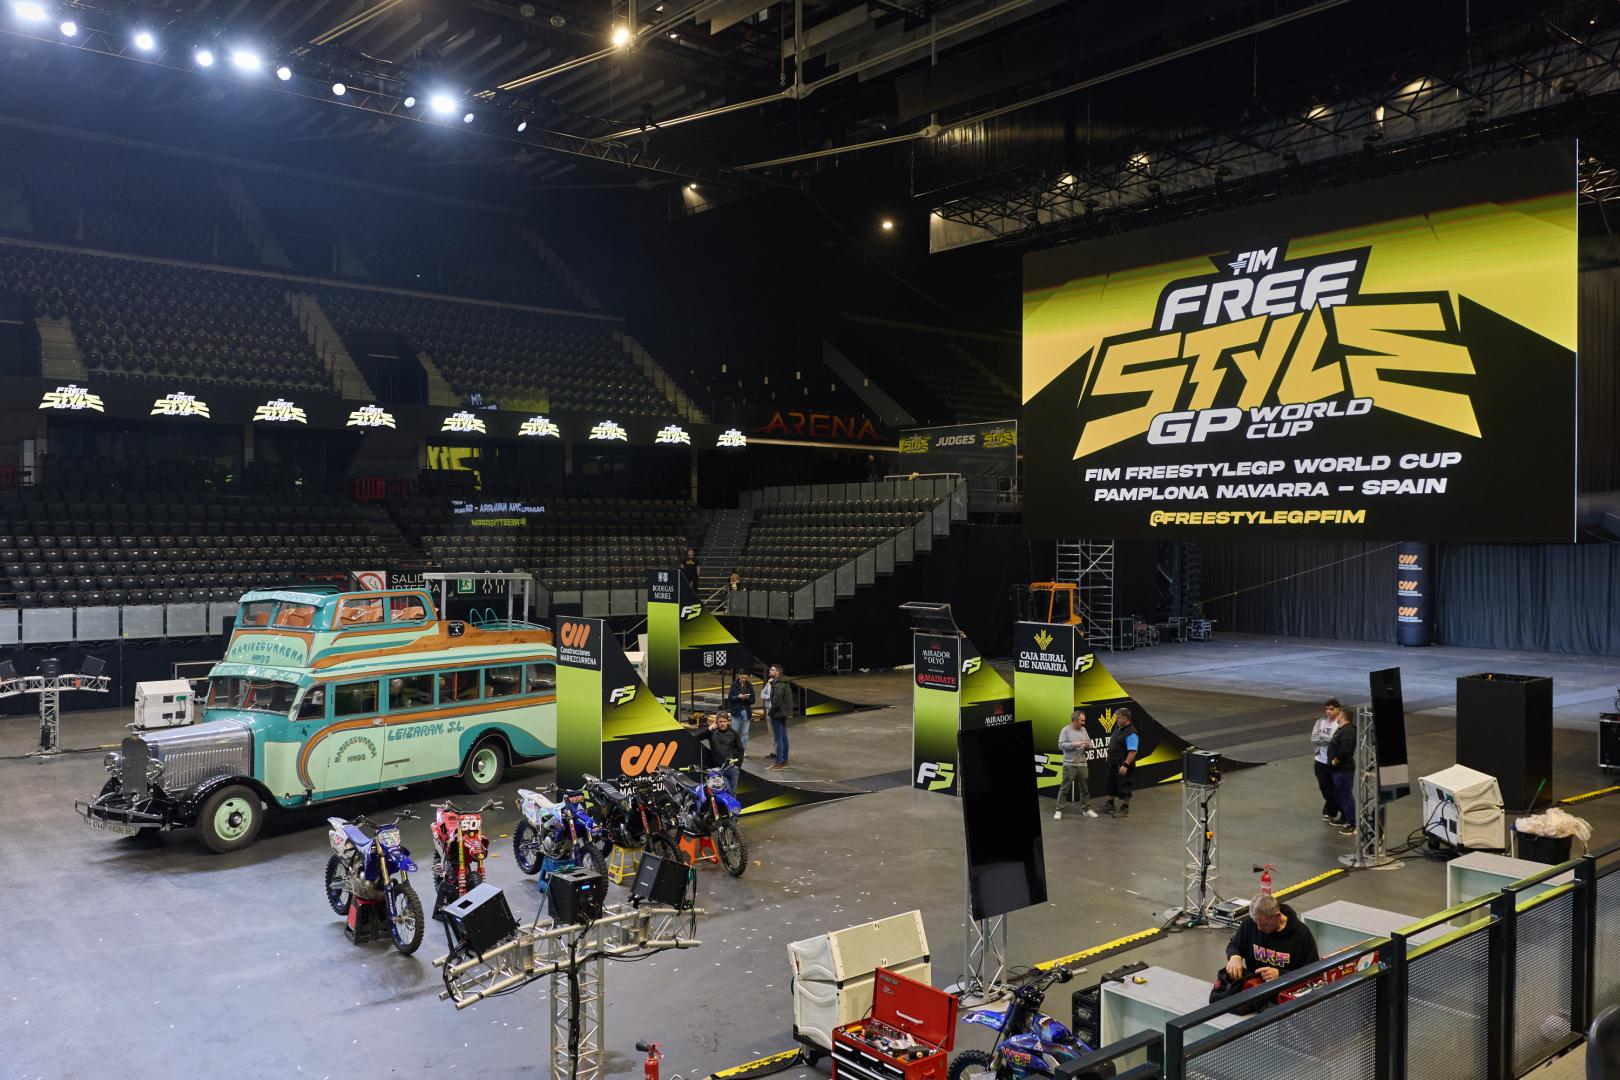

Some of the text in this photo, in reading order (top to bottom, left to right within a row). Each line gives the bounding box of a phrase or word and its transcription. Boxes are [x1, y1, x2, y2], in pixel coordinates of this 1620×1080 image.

[1228, 247, 1278, 275] FIM
[1159, 259, 1357, 331] FREE
[1073, 302, 1483, 460] STYLE
[754, 411, 886, 441] ARENA
[1146, 398, 1374, 445] GP WORLD
[1246, 420, 1314, 439] CUP
[936, 434, 976, 447] JUDGES
[1085, 451, 1462, 482] FIM FREESTYLEGP WORLD CUP
[1094, 485, 1209, 502] PAMPLONA
[1216, 481, 1329, 499] NAVARRA
[1362, 478, 1448, 495] SPAIN
[1150, 509, 1366, 527] @FREESTYLEGPFIM
[560, 646, 591, 656] Construcciones
[922, 649, 951, 659] MIRADOR
[1020, 651, 1066, 663] CAJA RURAL
[560, 655, 597, 666] MARIEZCURRENA
[1019, 660, 1068, 673] DE NAVARRA
[985, 714, 1013, 725] MIRADOR
